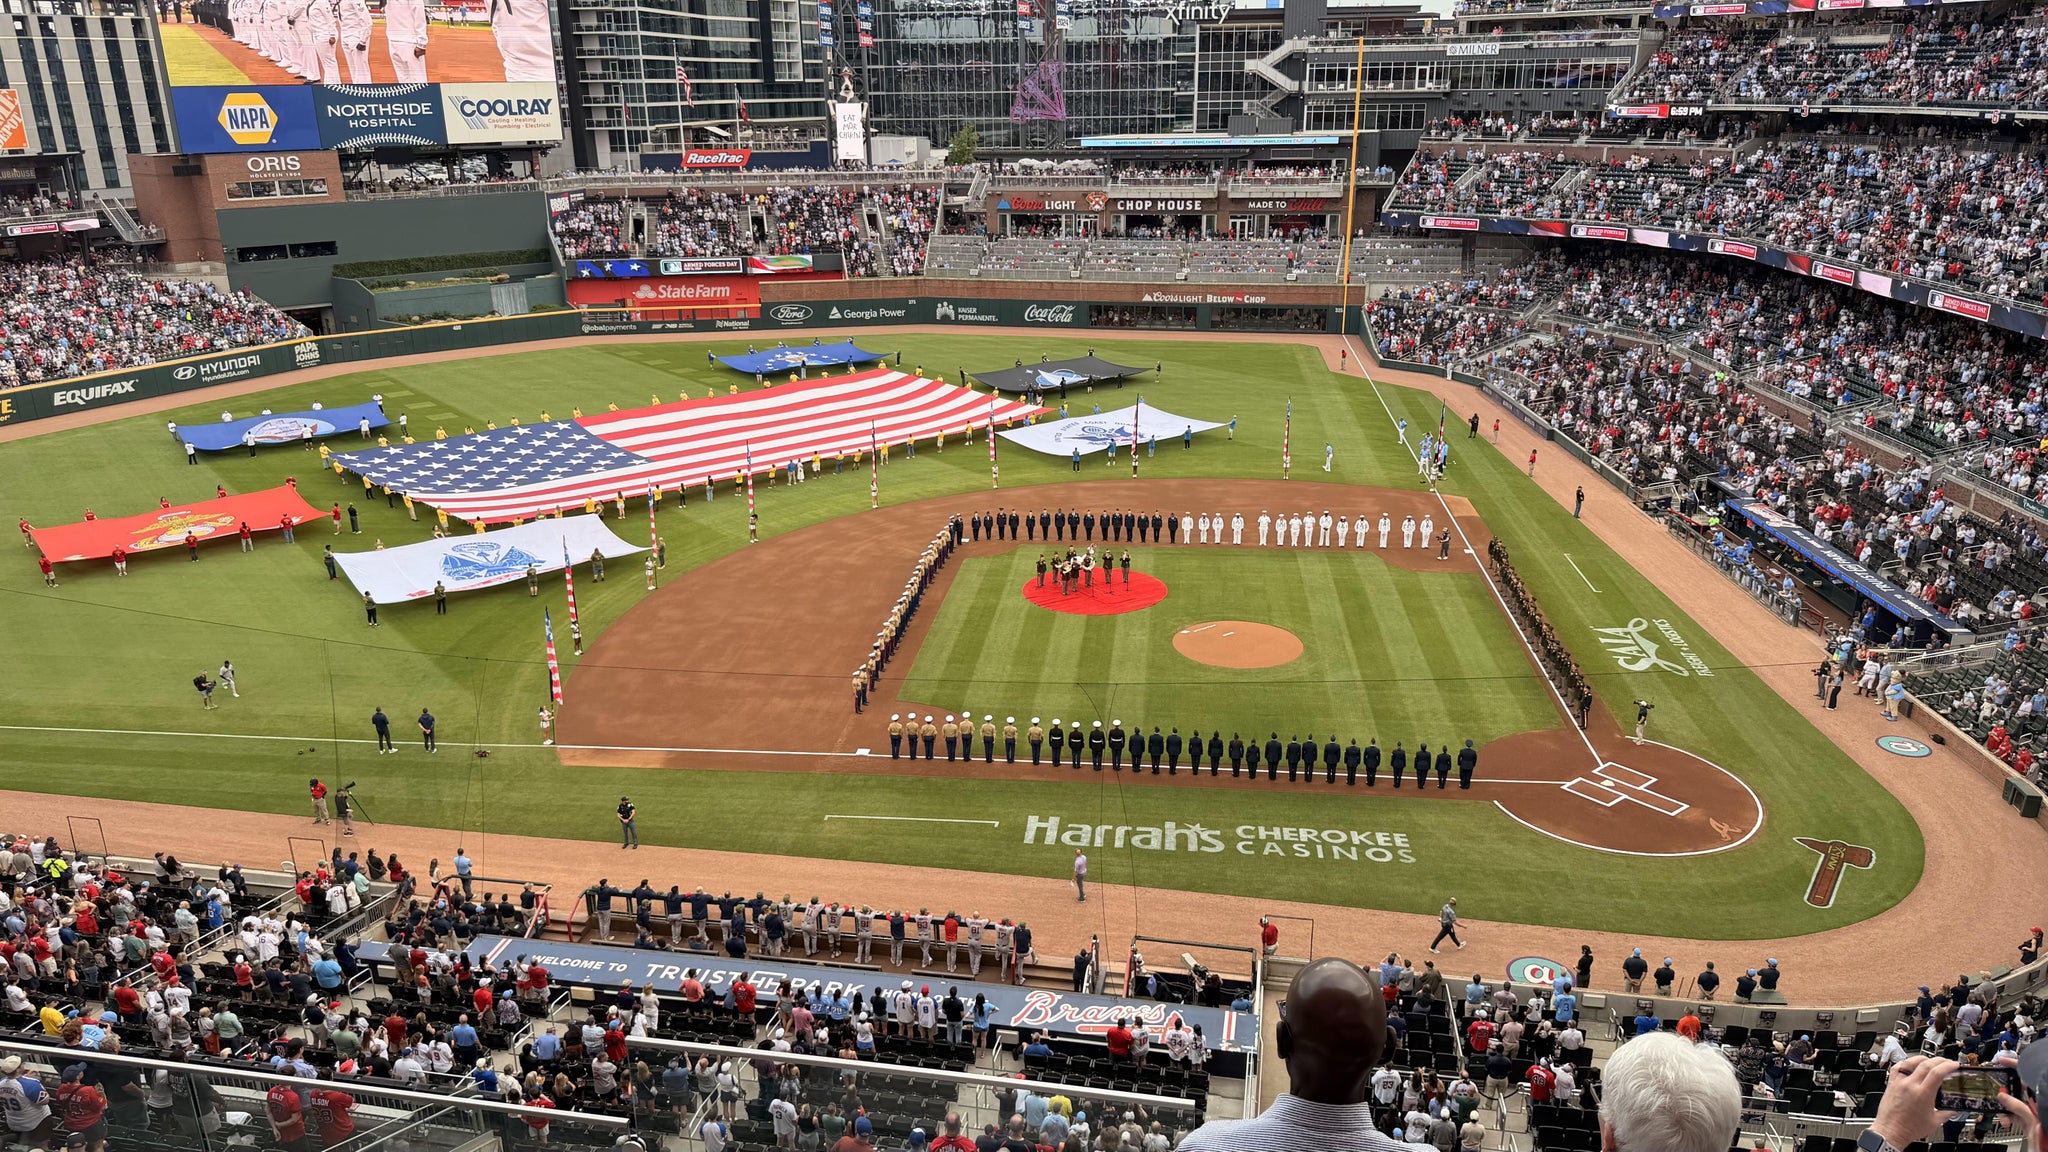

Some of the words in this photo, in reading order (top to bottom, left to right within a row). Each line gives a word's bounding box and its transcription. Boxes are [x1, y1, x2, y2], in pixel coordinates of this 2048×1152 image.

[1165, 1, 1231, 25] xfinity
[1458, 44, 1497, 55] MILNER
[327, 103, 433, 117] NORTHSIDE
[460, 98, 553, 118] COOLRAY
[1670, 107, 1688, 116] 6:59
[1689, 107, 1703, 116] PM
[227, 108, 270, 130] NAPA
[349, 118, 416, 128] HOSPITAL
[843, 114, 856, 123] EAT
[247, 155, 301, 172] ORIS
[686, 152, 744, 165] RaceTrac
[1011, 196, 1044, 210] Coors
[1045, 200, 1076, 210] LIGHT
[1117, 200, 1152, 210] CHOP
[1157, 200, 1202, 210] HOUSE
[1248, 201, 1273, 209] MADE
[1275, 201, 1287, 209] TO
[1153, 291, 1178, 302] Coors
[1207, 294, 1235, 303] BELOW
[1244, 294, 1266, 304] CHOP
[777, 306, 805, 319] Ford
[843, 309, 878, 320] Georgia
[879, 308, 906, 318] Power
[1024, 303, 1076, 323] Coca-Cola
[723, 320, 750, 328] National
[294, 341, 318, 354] PAPA
[295, 351, 320, 363] JOHNS
[200, 354, 261, 376] HYUNDAI
[202, 369, 250, 382] HyundaiUSA.com
[54, 379, 136, 406] EQUIFAX
[1235, 825, 1410, 848] CHEROKEE
[1236, 841, 1417, 863] CASINOS
[531, 954, 606, 970] WELCOME
[608, 962, 628, 972] TO
[790, 979, 865, 997] PARK
[1010, 990, 1167, 1026] Braves
[1563, 1003, 1570, 1012] 3
[433, 1052, 441, 1061] 9
[775, 1111, 783, 1120] 3
